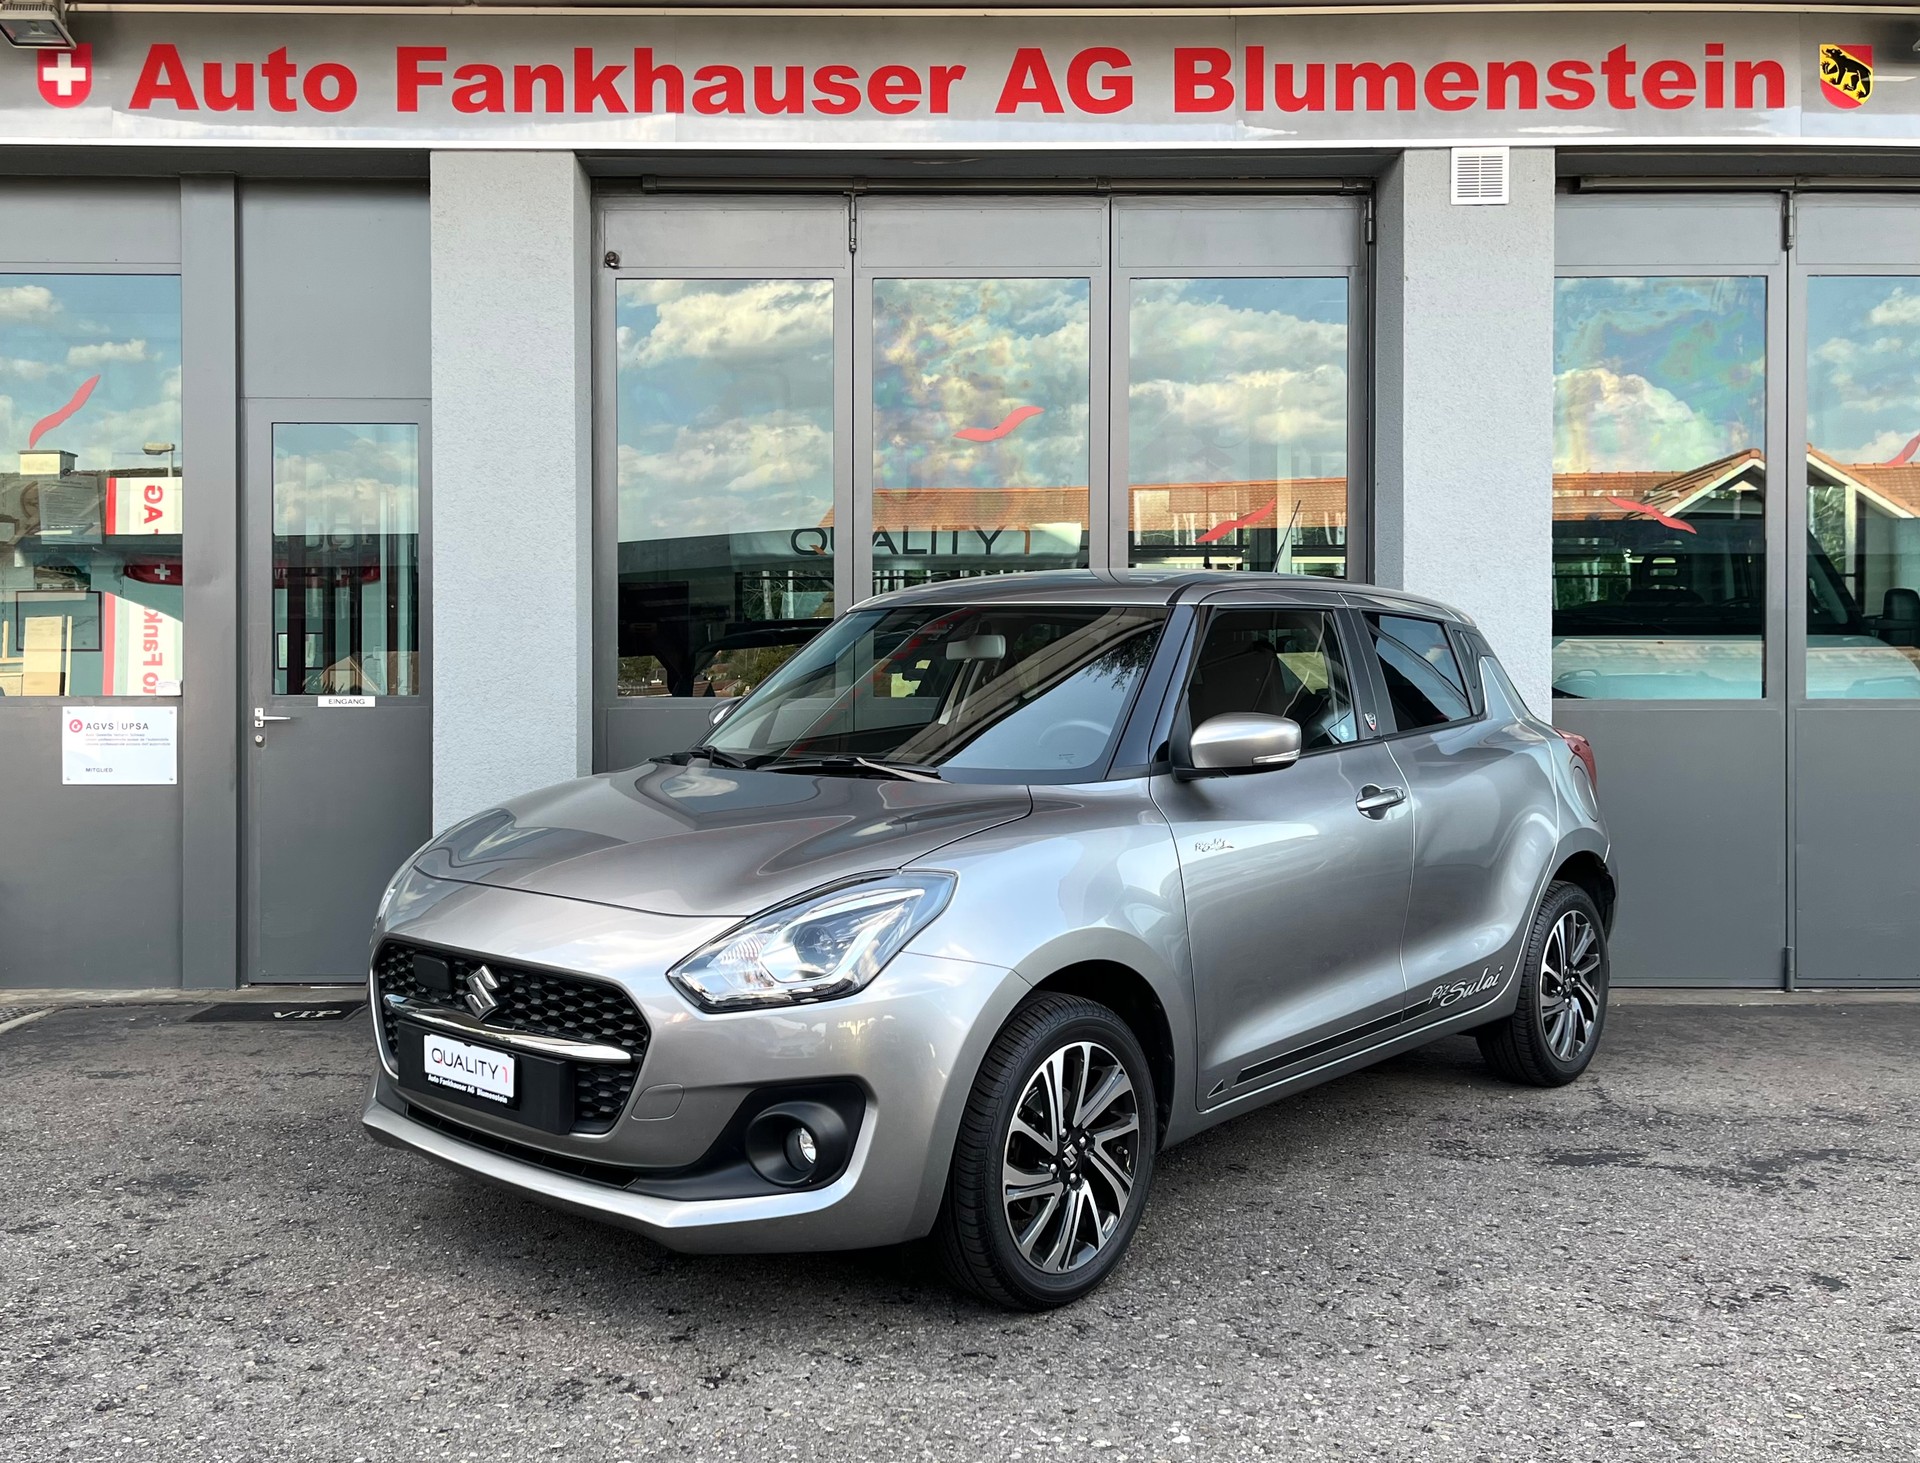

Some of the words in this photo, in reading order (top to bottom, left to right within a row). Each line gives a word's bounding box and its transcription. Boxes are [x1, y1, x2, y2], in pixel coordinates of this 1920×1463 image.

[129, 44, 358, 112] Auto
[396, 47, 966, 114] Fankhauser
[995, 46, 1133, 113] AG
[1173, 43, 1785, 113] Blumenstein
[790, 525, 1008, 556] QALITY
[85, 722, 114, 730] AGVS
[121, 722, 149, 730] UPSA
[1440, 965, 1504, 1007] Sulai
[272, 1009, 342, 1019] VIP
[431, 1047, 499, 1080] QUALITY
[502, 1066, 509, 1084] 1
